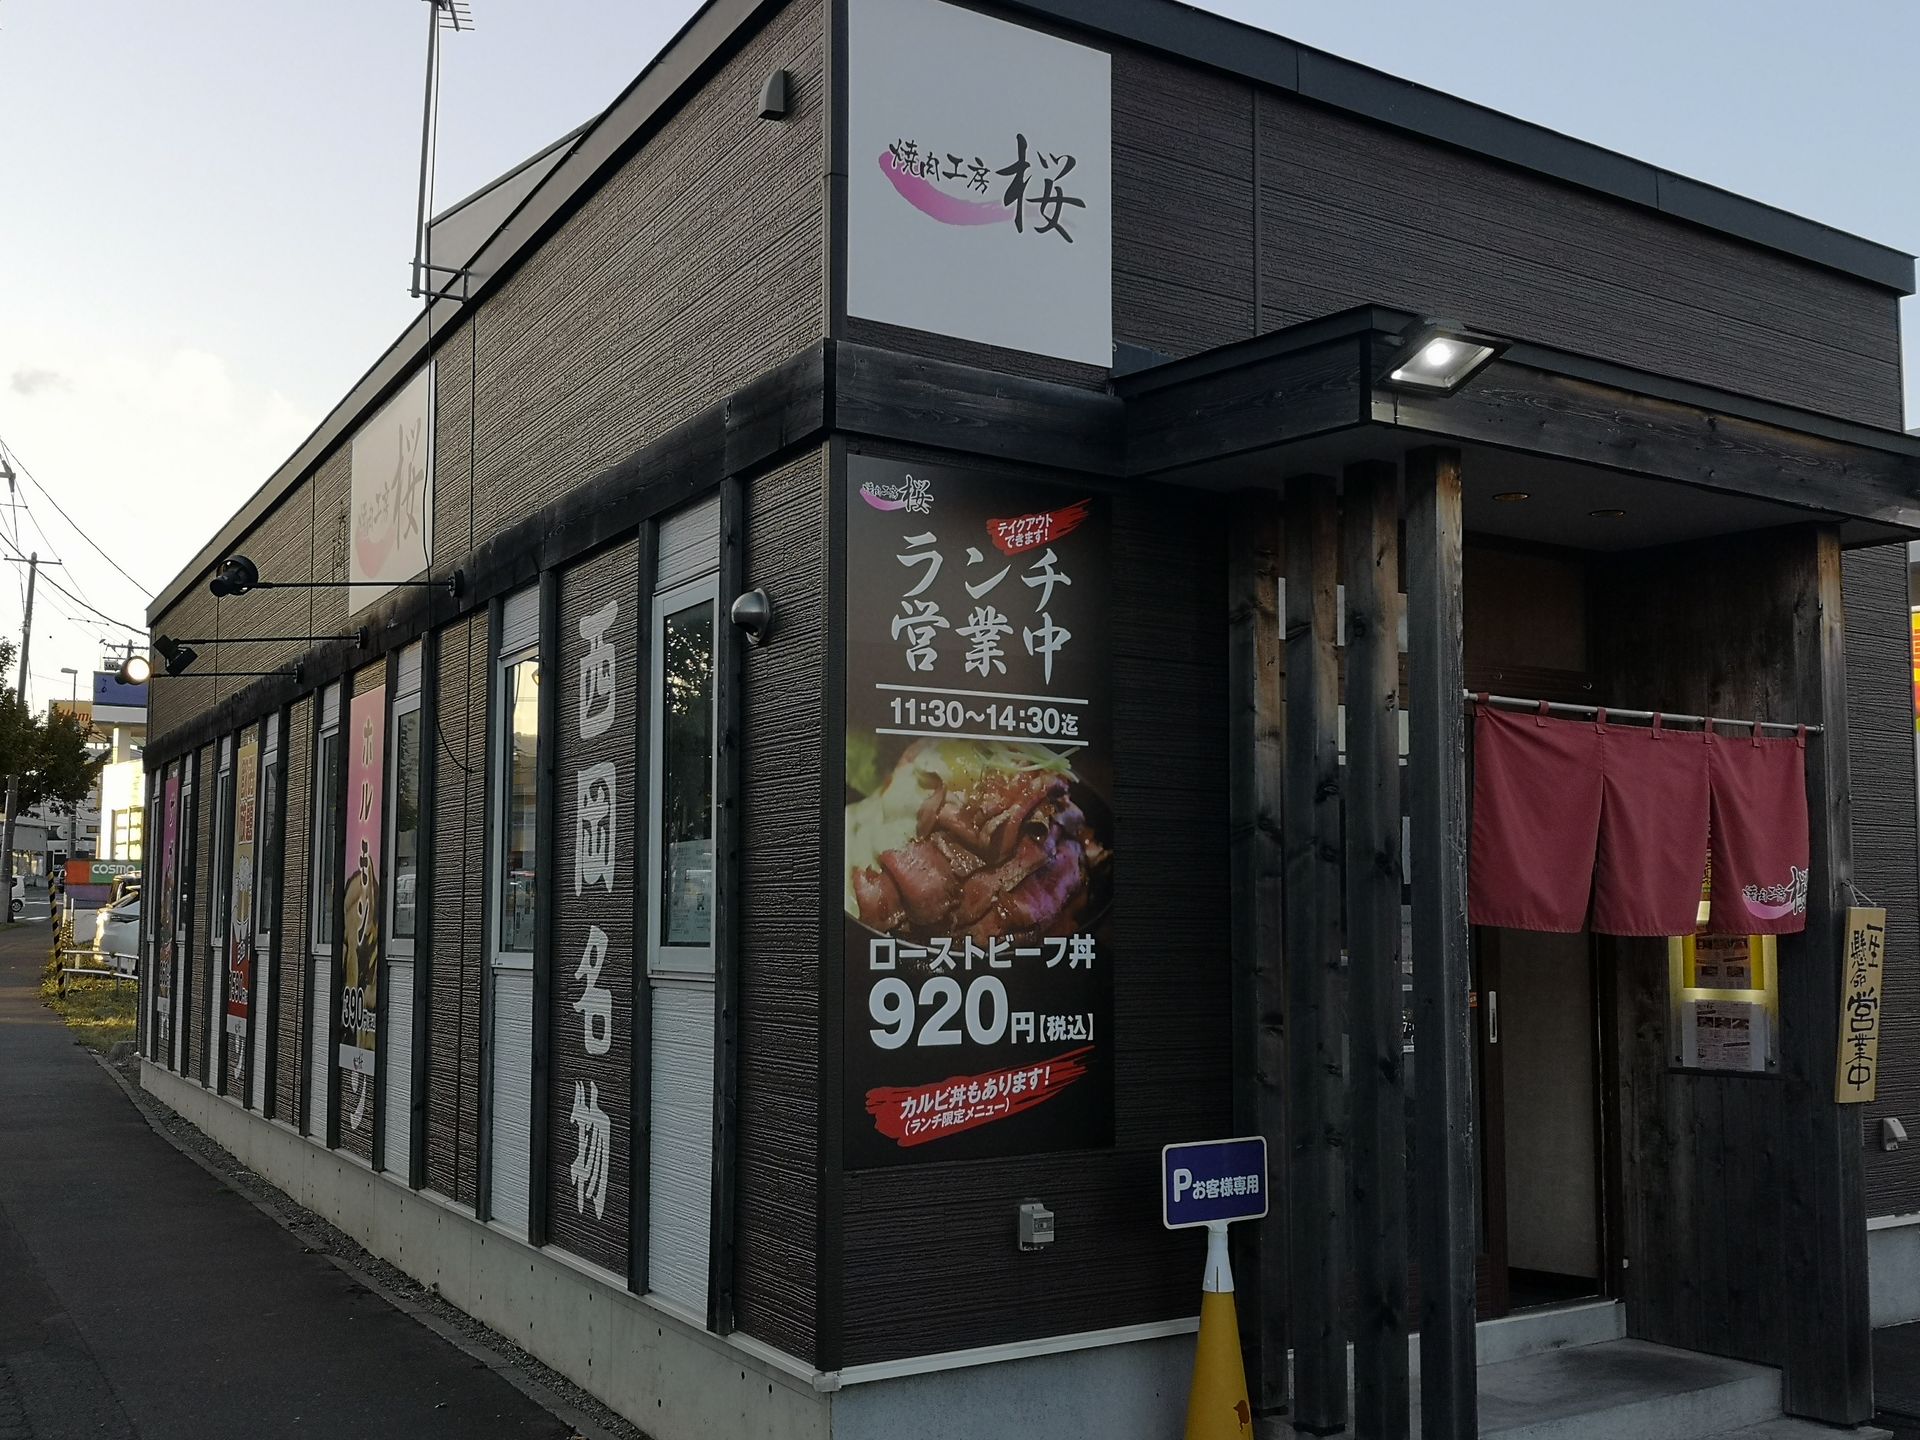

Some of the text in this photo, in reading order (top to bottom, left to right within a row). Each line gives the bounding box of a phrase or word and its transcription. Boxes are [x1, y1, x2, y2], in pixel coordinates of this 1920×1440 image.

[889, 133, 1087, 243] 焼肉工房 桜
[898, 474, 934, 514] 桜
[998, 514, 1053, 537] テイクアウト
[896, 531, 1072, 613] ランチ
[890, 599, 1072, 685] 営業中
[357, 715, 374, 946] ホルモン
[570, 599, 619, 1221] 西岡名物
[869, 934, 1096, 970] ローストビーフ丼
[900, 1066, 1051, 1120] カルビ丼もあります!
[1173, 1168, 1259, 1202] P お客様専用
